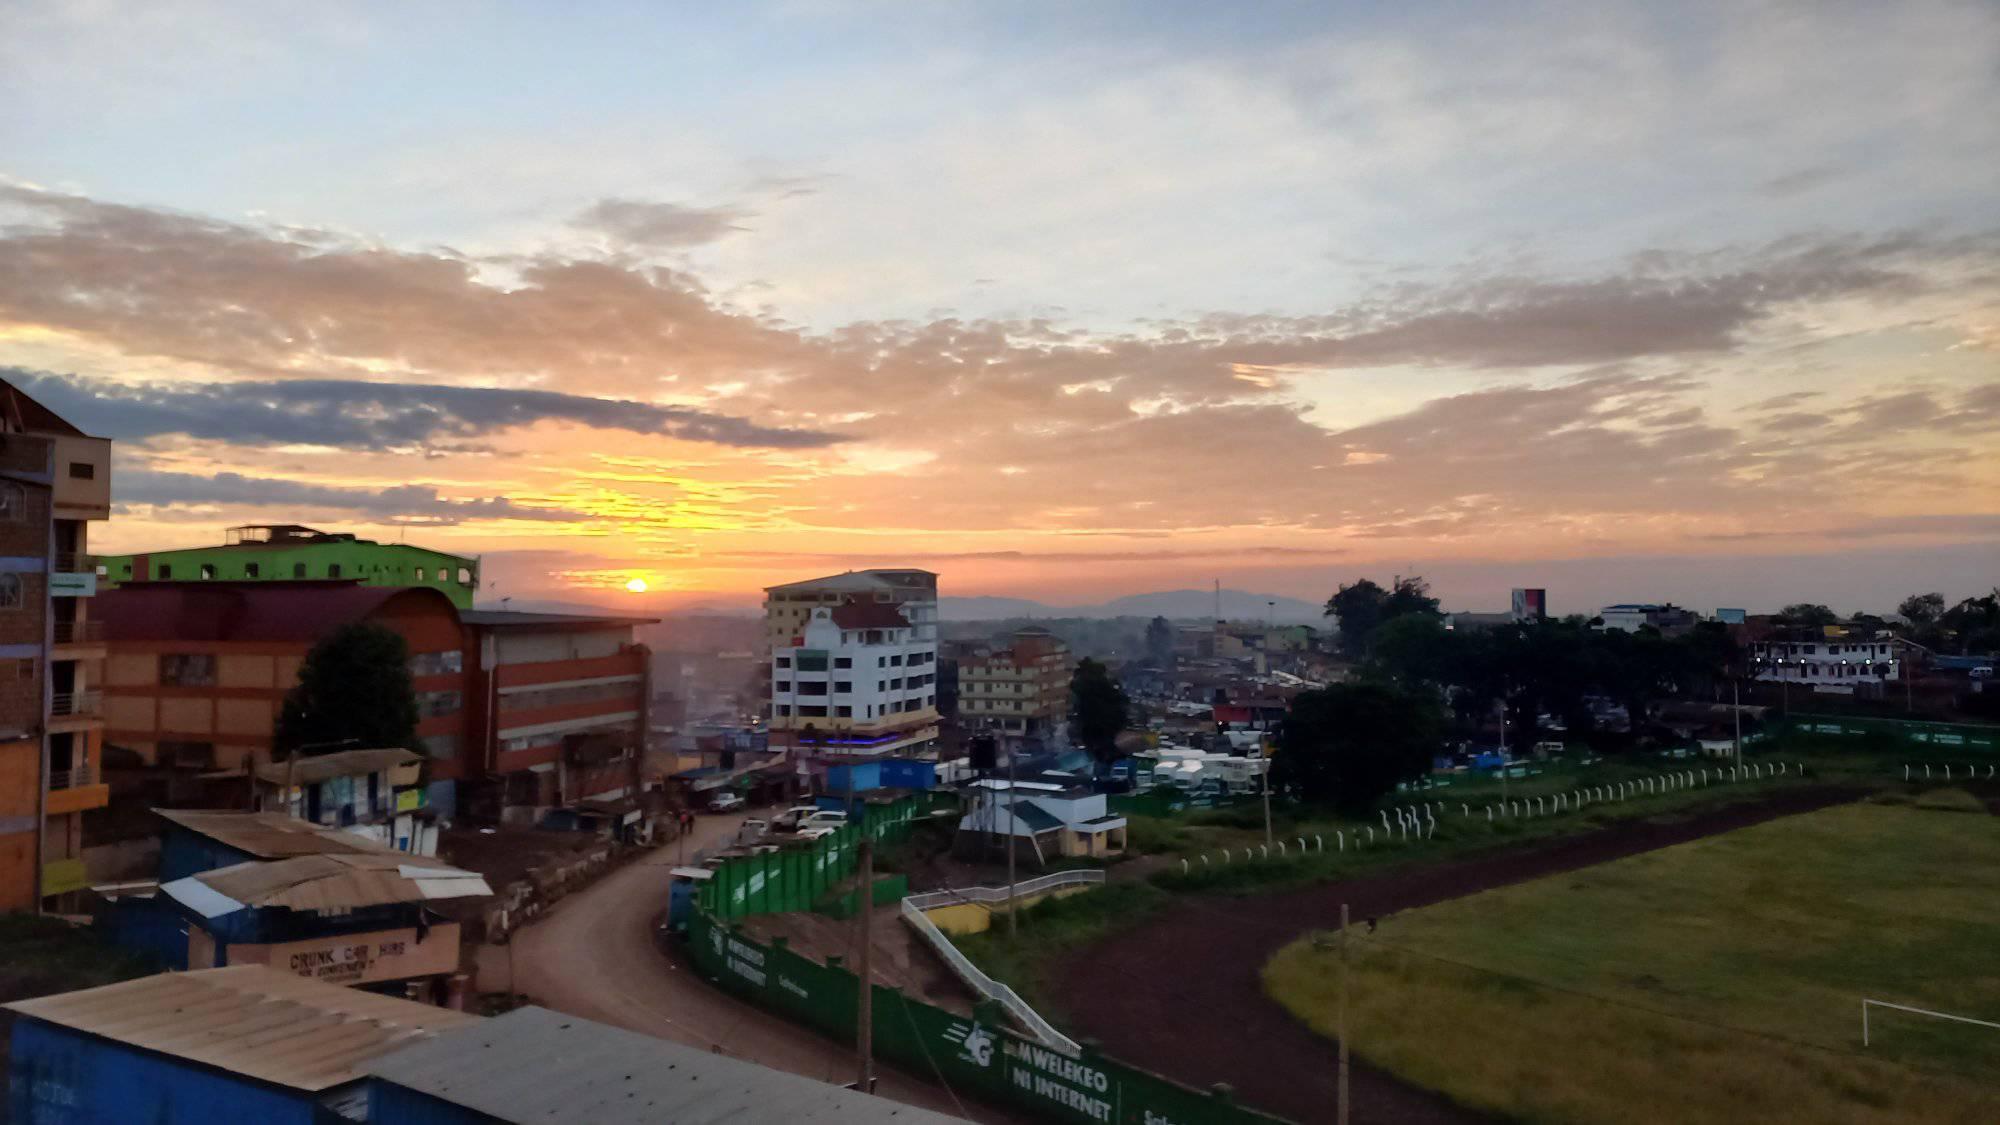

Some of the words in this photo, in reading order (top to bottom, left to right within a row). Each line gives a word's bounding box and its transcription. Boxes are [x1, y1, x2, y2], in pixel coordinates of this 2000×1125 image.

[1012, 1066, 1032, 1090] NI
[1035, 1074, 1112, 1122] INTERNET
[1017, 1041, 1108, 1093] MWELEKEO
